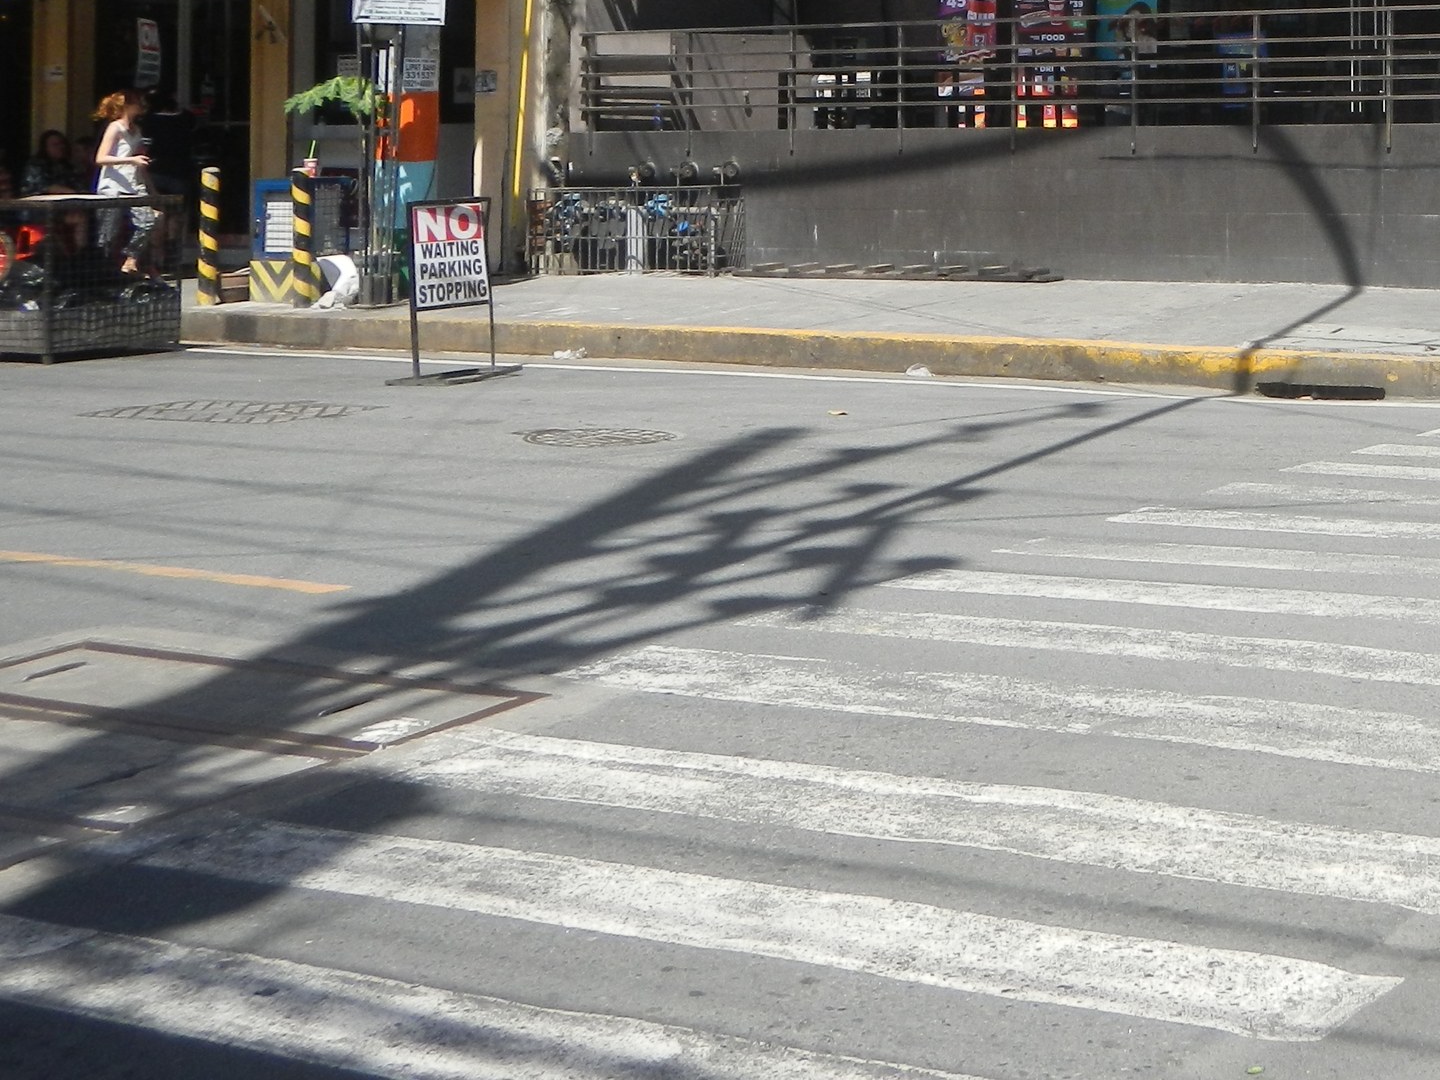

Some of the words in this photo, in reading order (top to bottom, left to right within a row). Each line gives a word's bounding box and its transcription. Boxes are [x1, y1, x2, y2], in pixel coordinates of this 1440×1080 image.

[417, 206, 478, 241] NO
[421, 240, 479, 259] WAITING
[421, 259, 482, 280] PARKING
[419, 279, 487, 303] STOPPING
